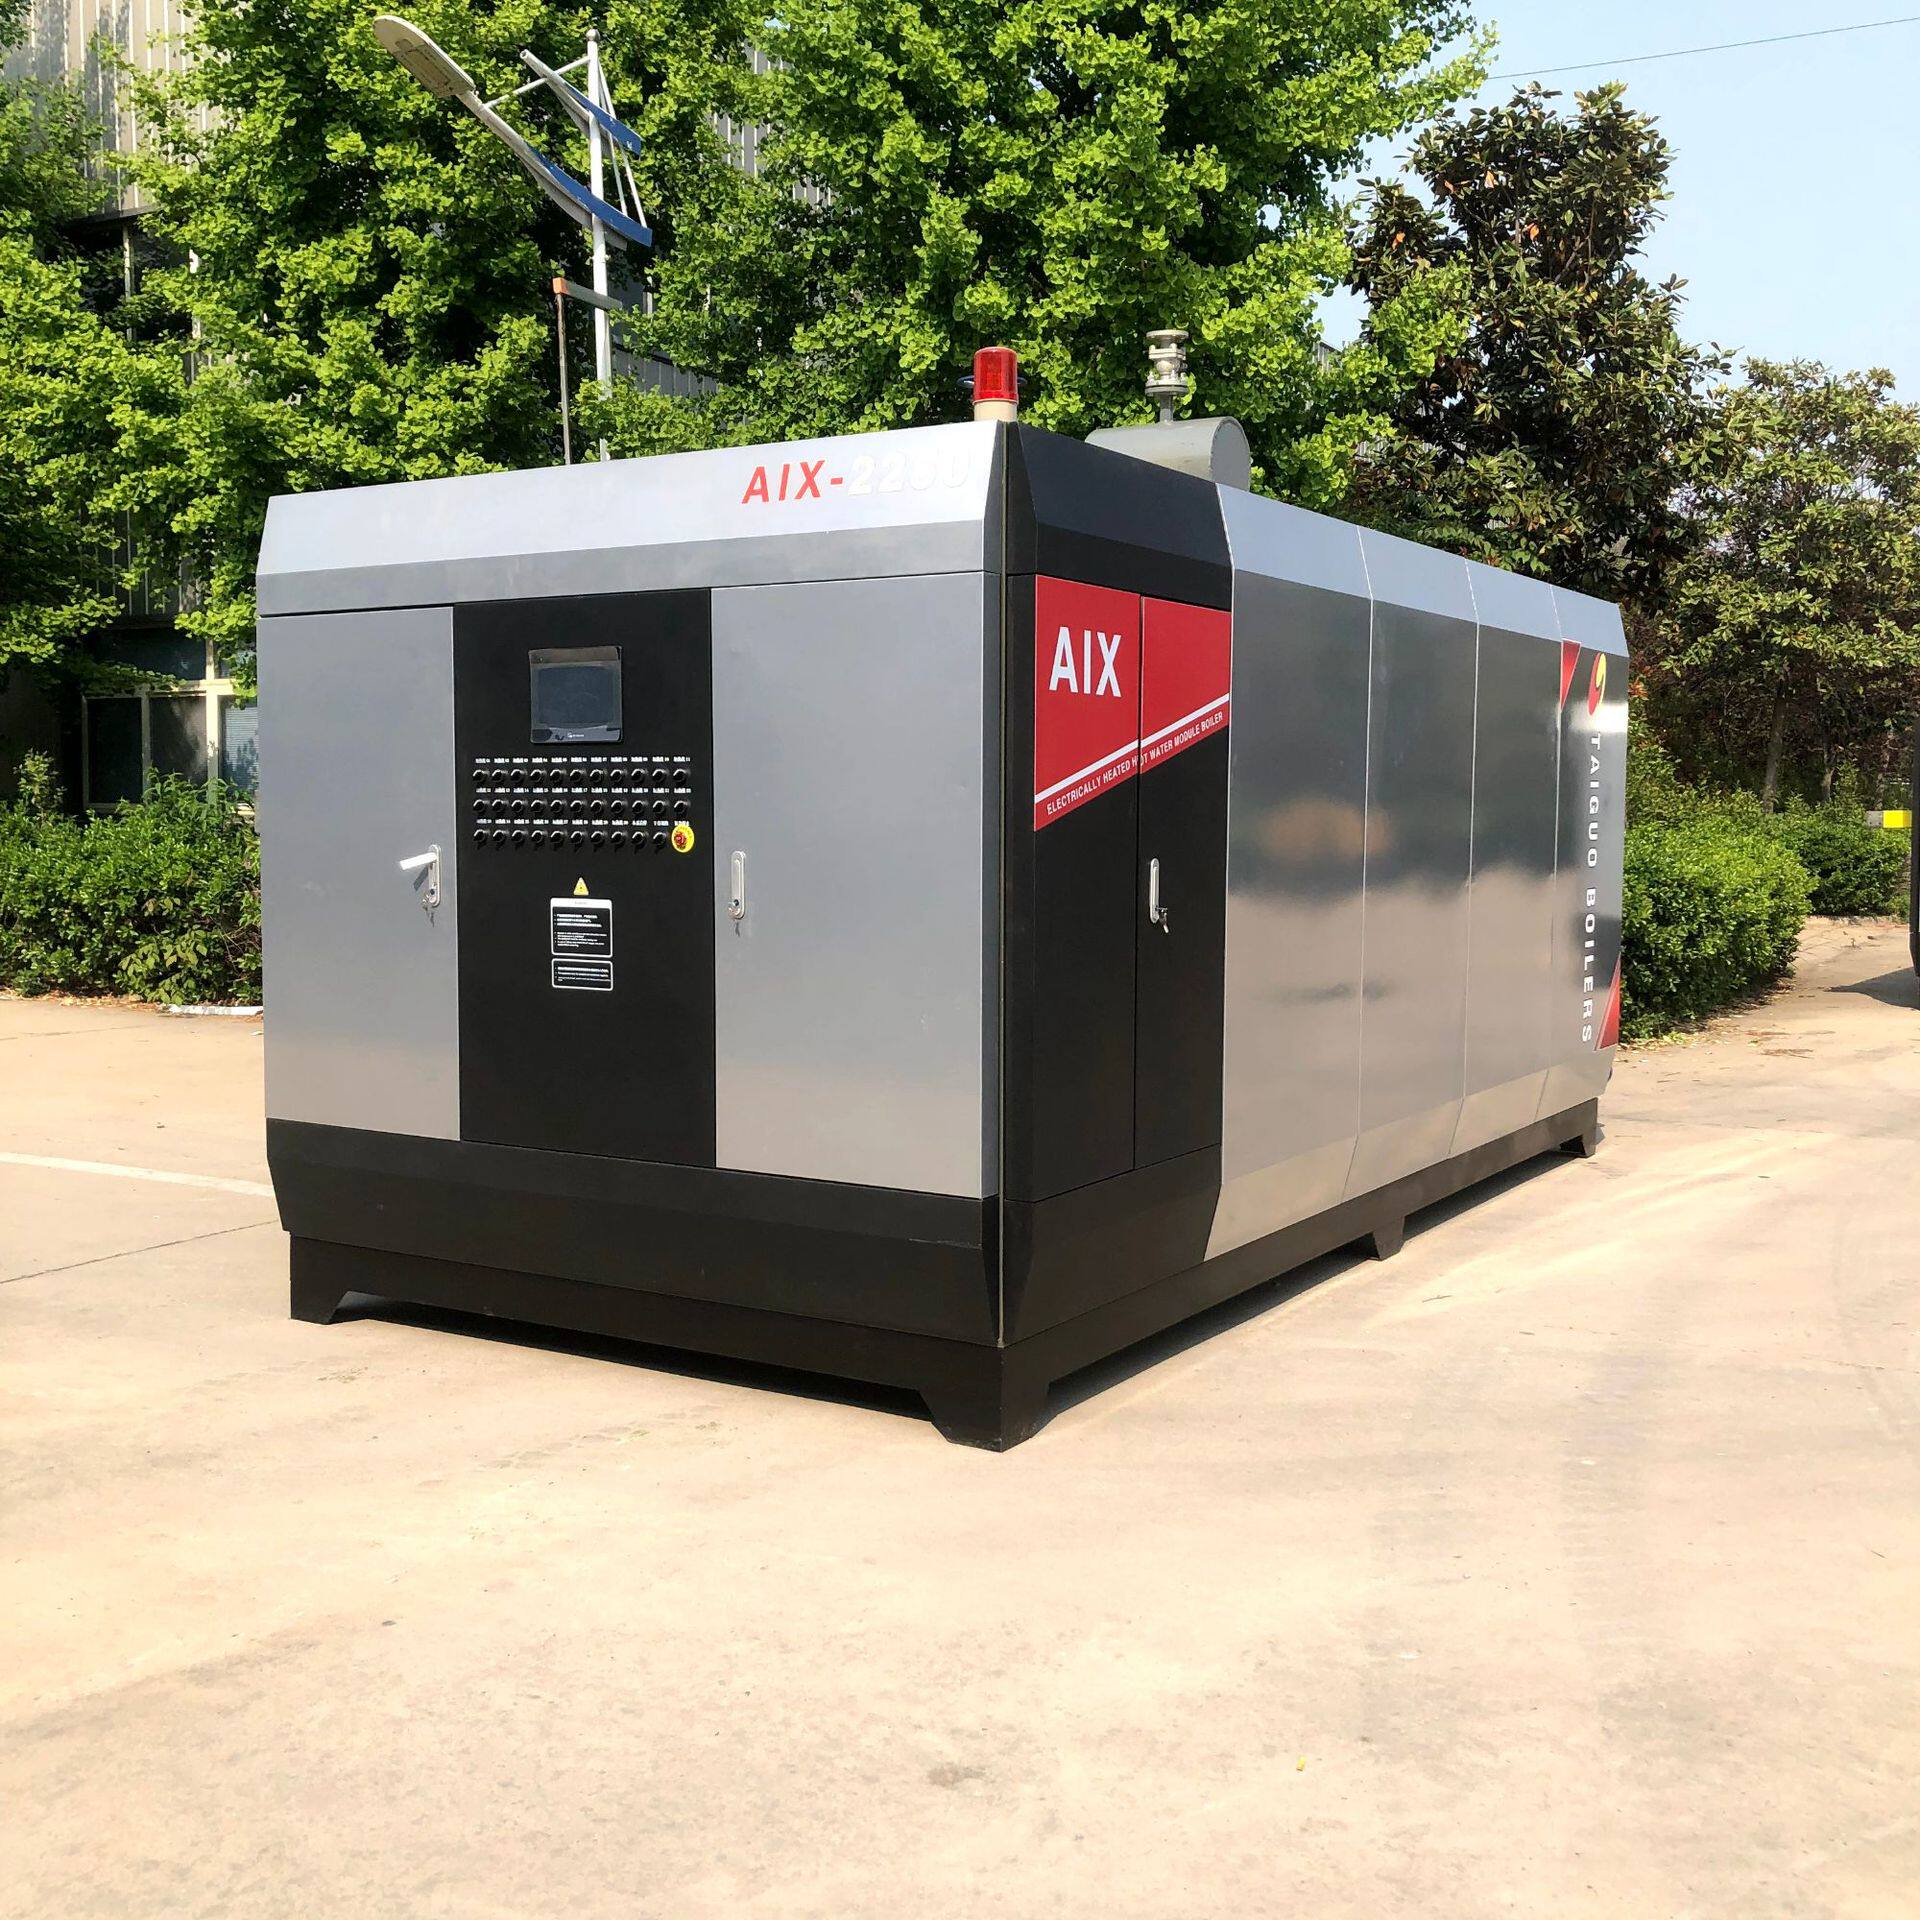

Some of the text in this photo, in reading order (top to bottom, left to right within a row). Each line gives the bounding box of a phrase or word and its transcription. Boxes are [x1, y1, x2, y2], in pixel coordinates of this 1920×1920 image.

[1048, 626, 1122, 698] AIX
[1046, 711, 1223, 815] ELECTRICALLY HEATED HOT WATER MODULE BOILER
[1582, 732, 1601, 1042] TAIGUO BOILERS
